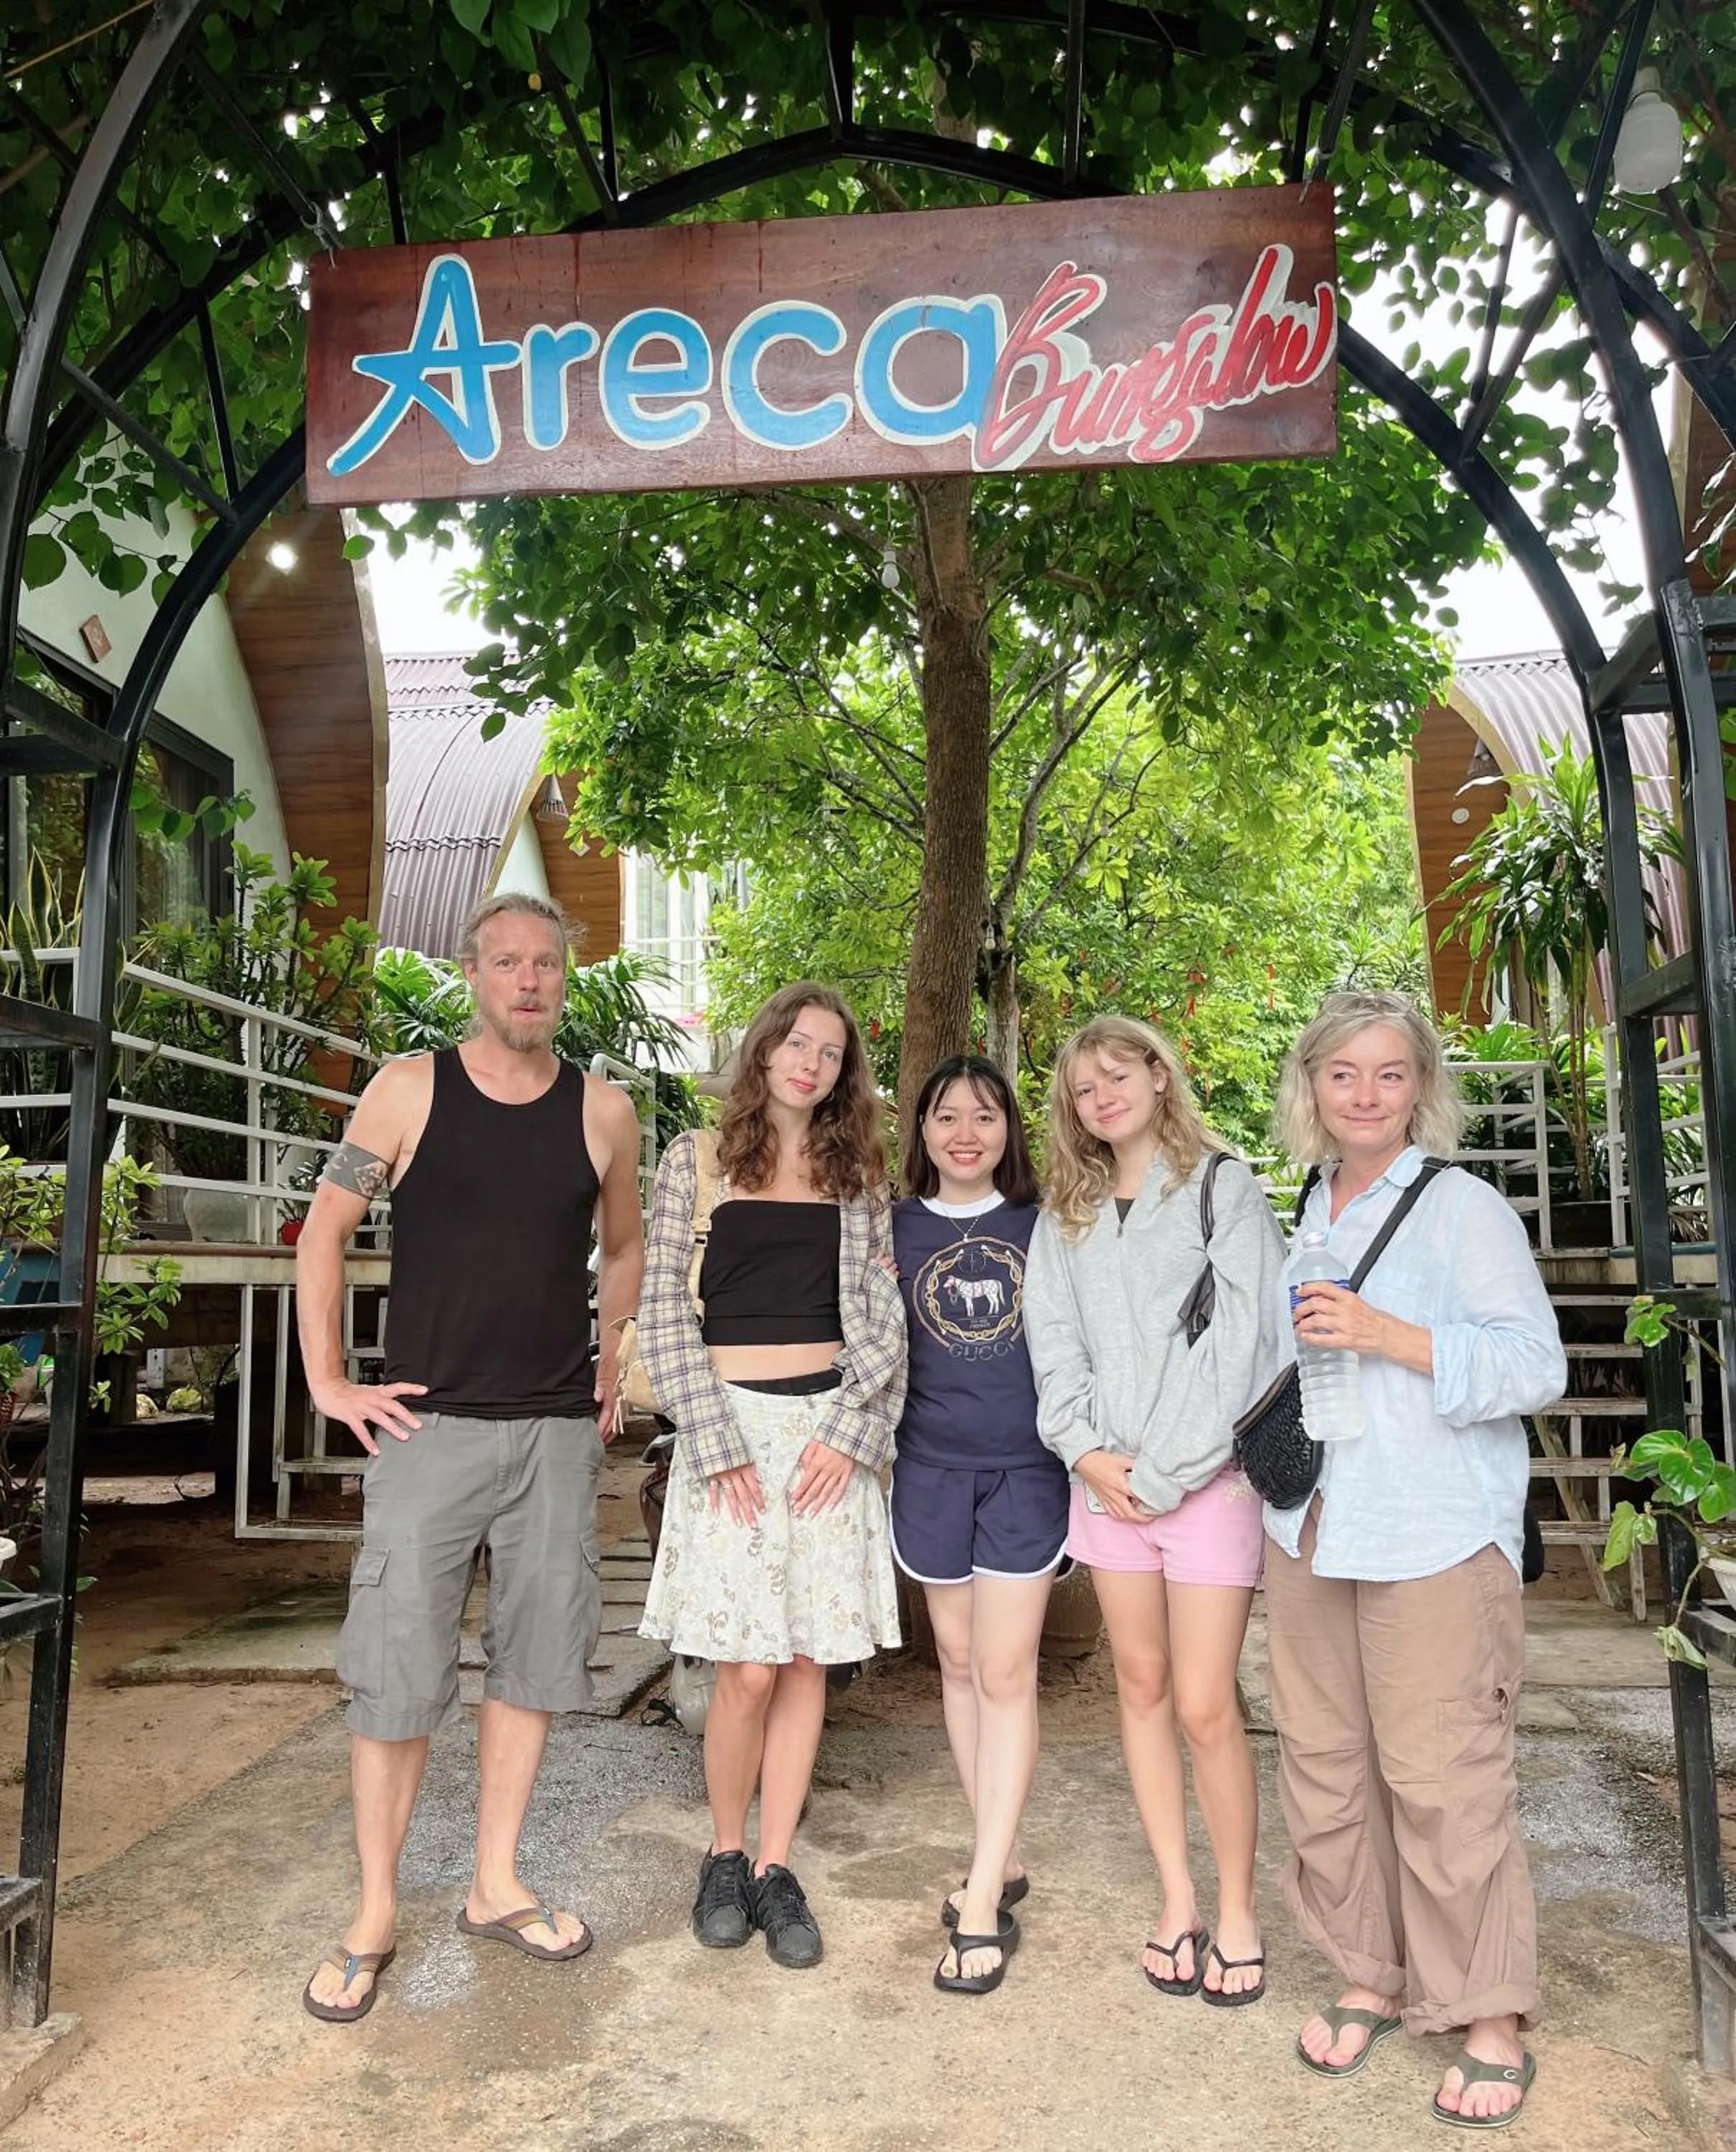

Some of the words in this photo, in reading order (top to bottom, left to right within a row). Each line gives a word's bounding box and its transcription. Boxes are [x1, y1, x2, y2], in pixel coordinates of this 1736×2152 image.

[328, 253, 1008, 476] Areca
[971, 244, 1337, 471] Bungalow
[948, 1339, 1015, 1361] GUCCI
